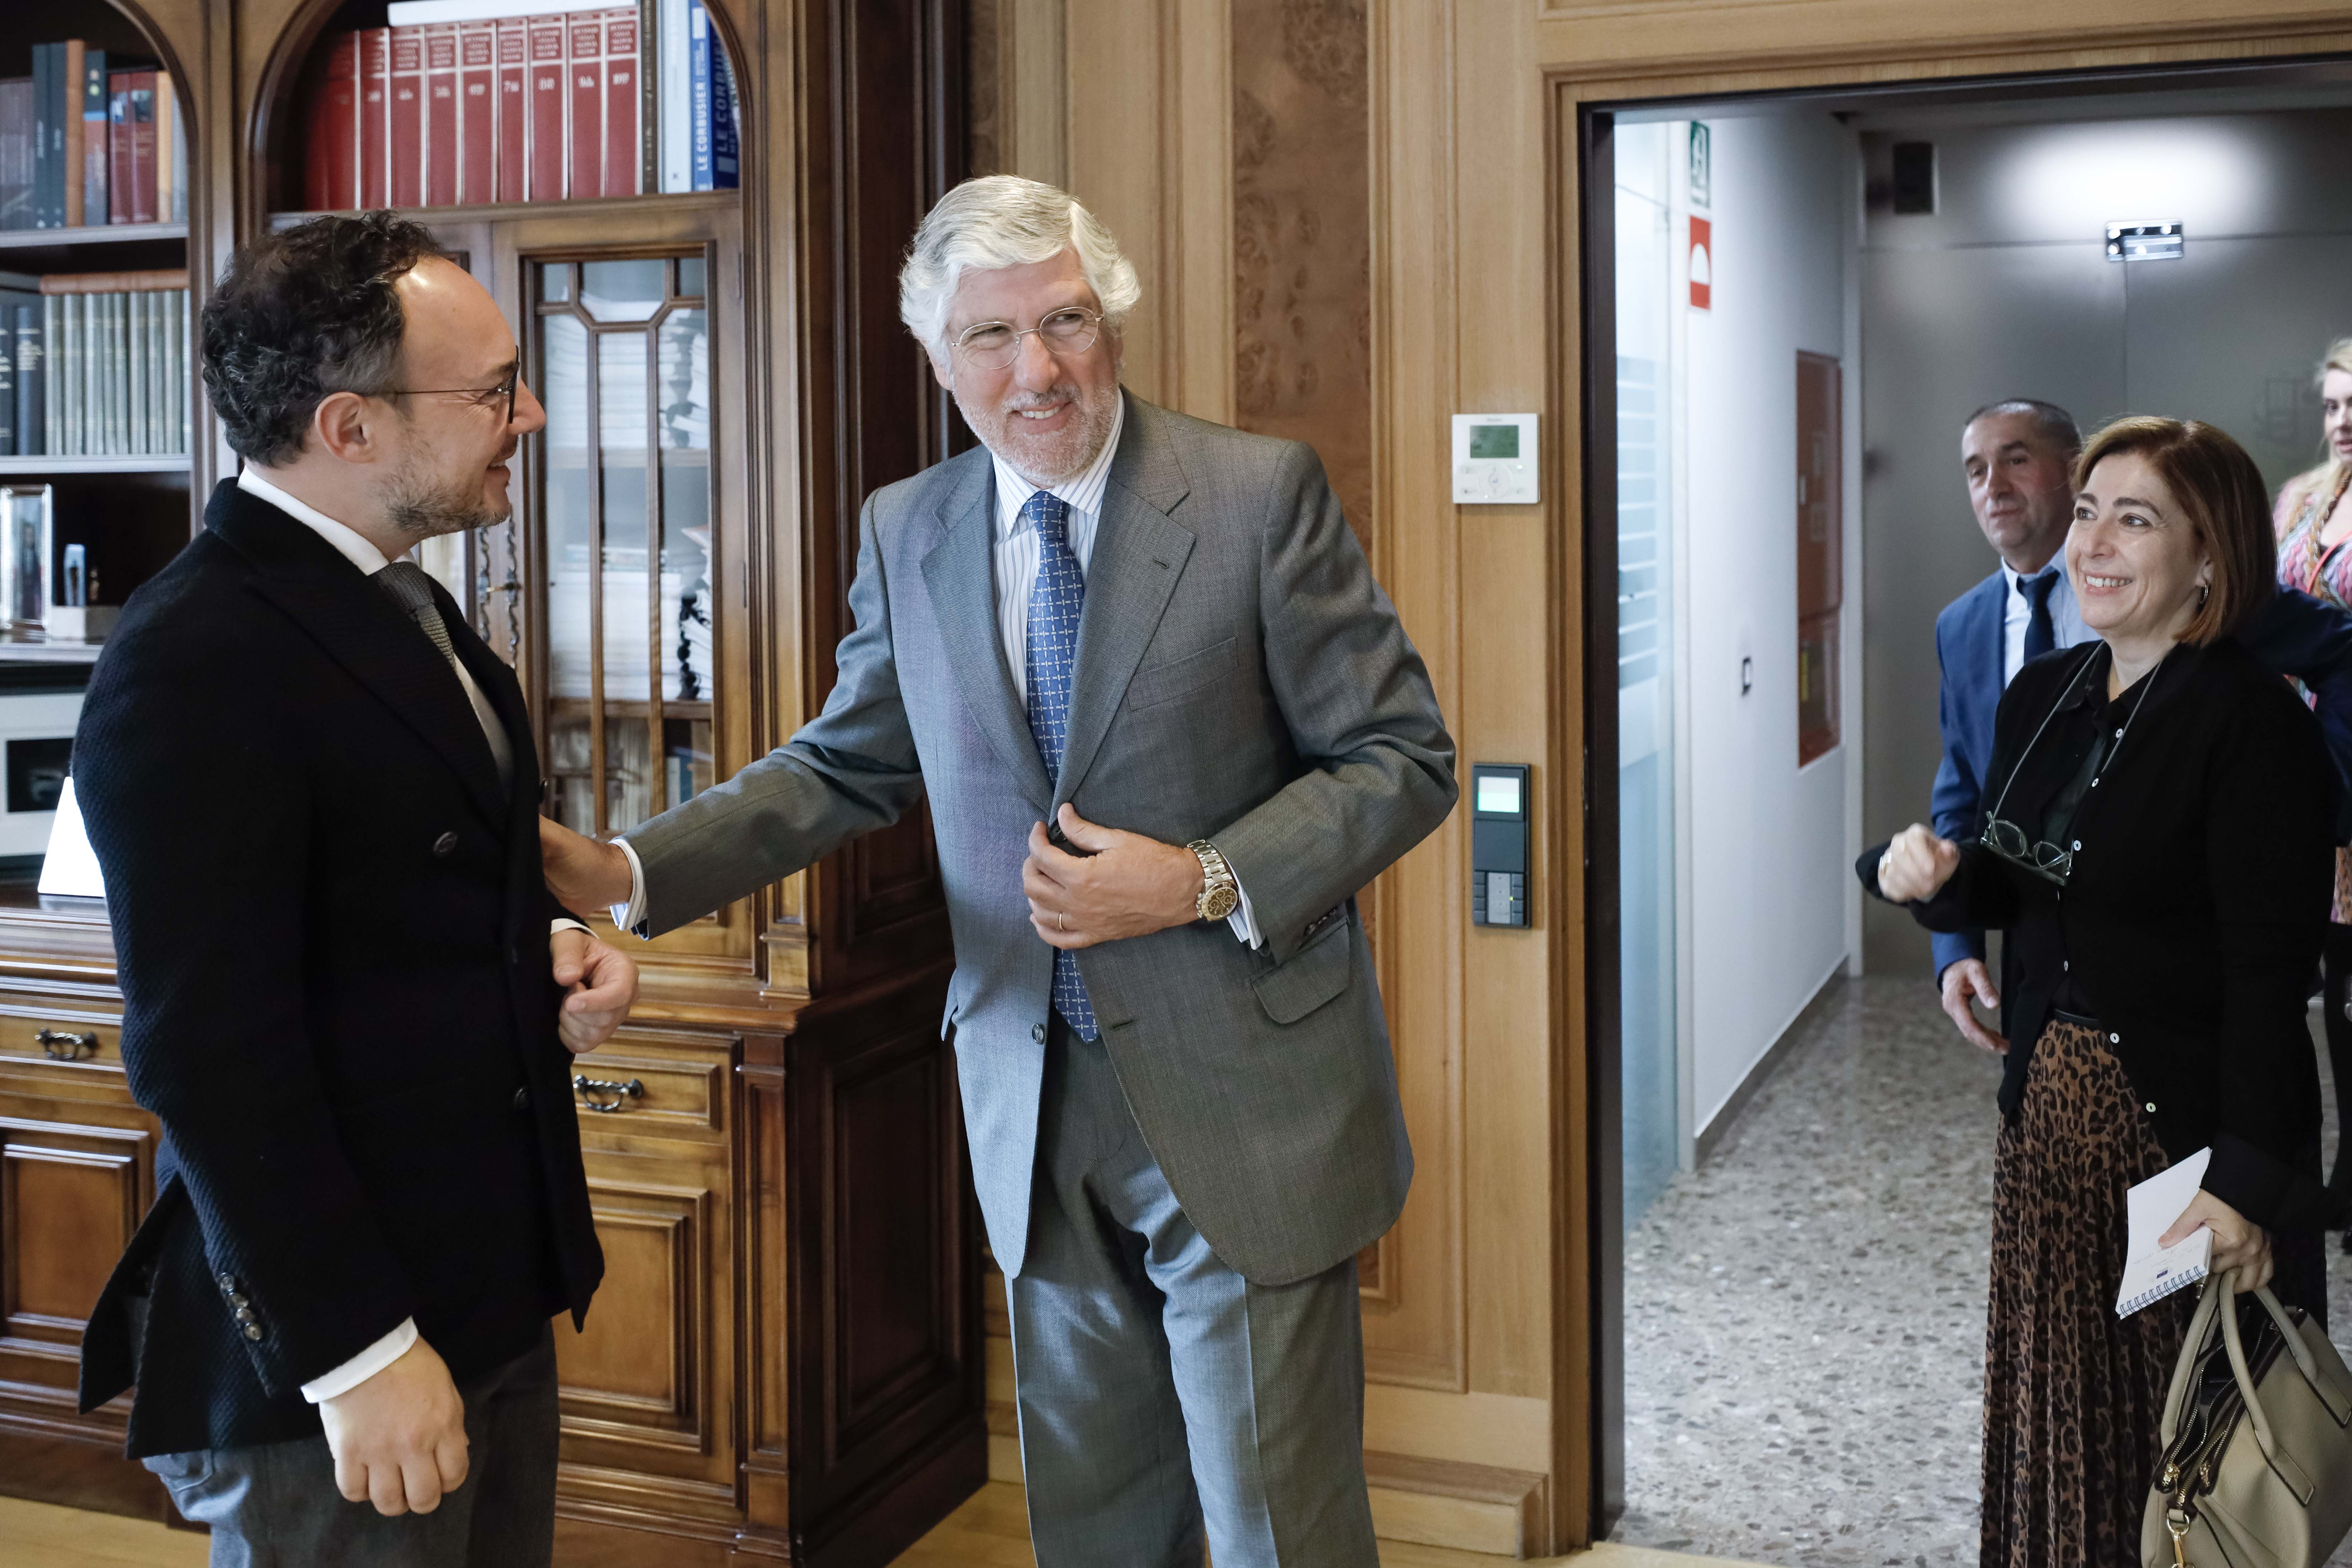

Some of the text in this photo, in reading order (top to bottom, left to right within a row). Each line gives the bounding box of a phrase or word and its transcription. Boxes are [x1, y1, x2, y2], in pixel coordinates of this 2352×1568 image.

[695, 82, 707, 153] CORBUSIER
[716, 129, 728, 153] LE
[697, 155, 708, 171] LE
